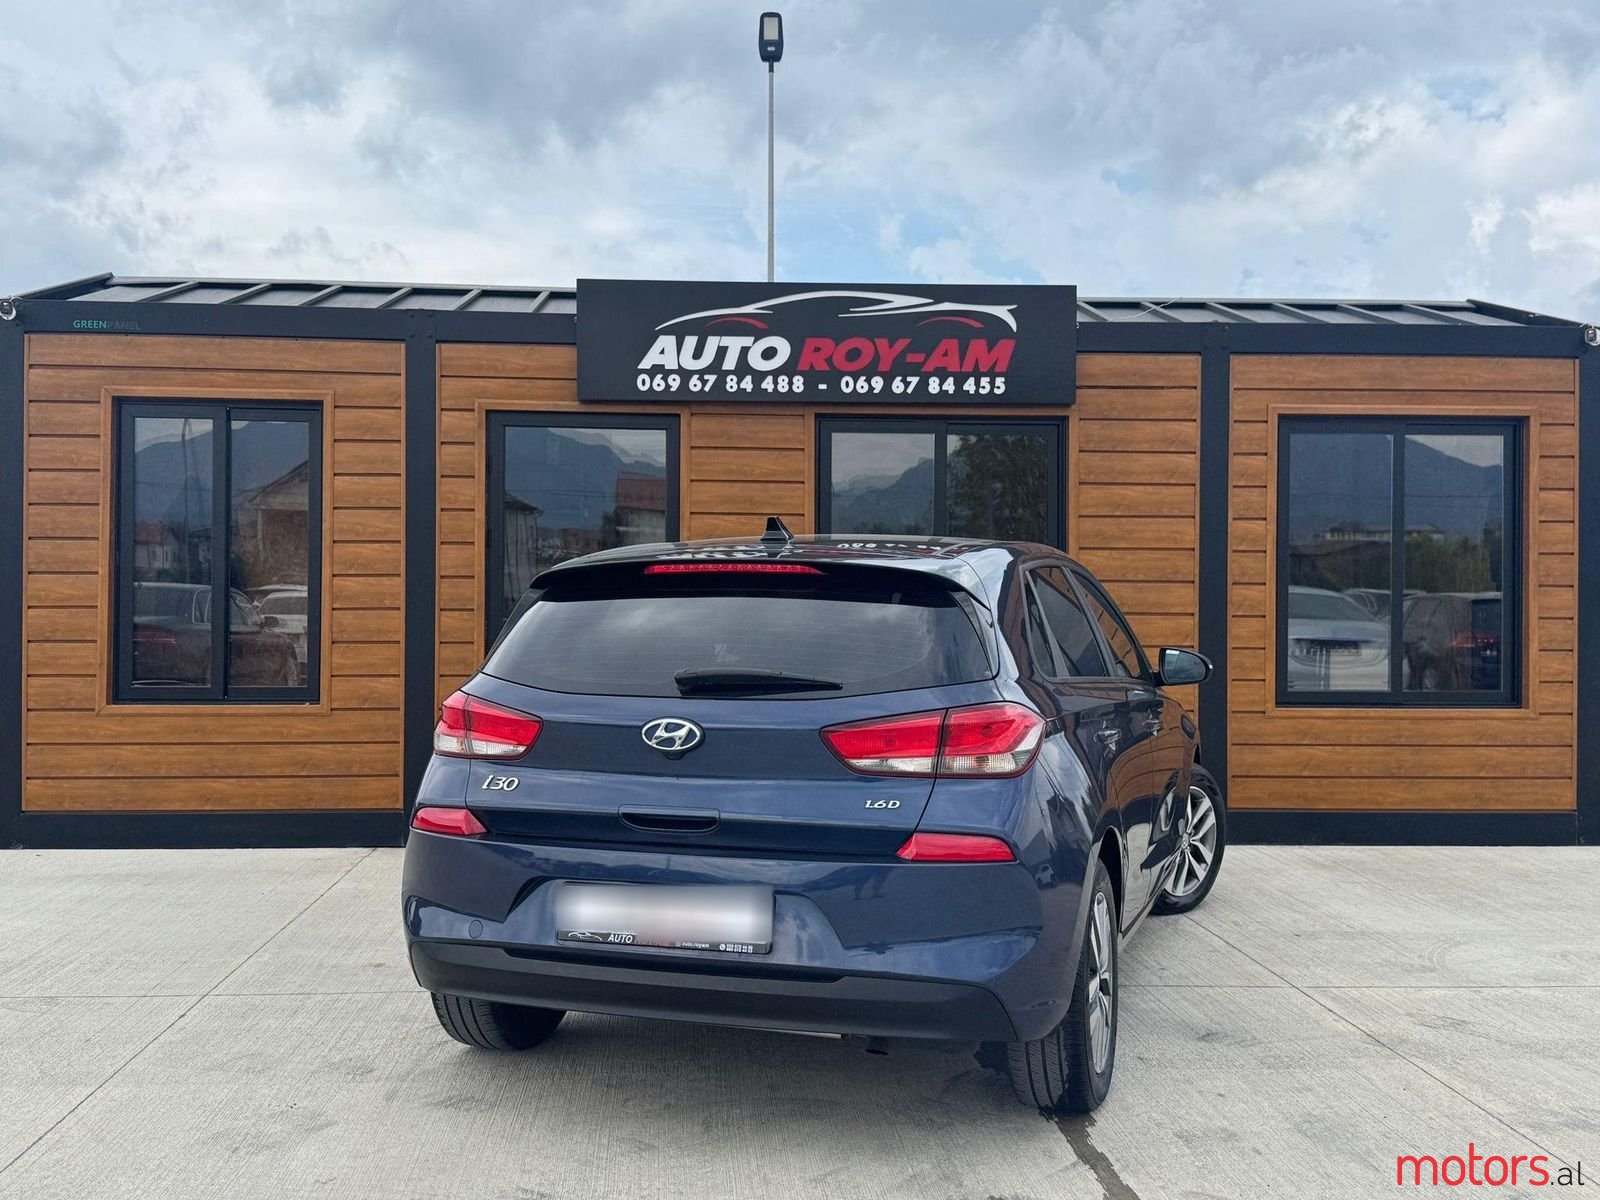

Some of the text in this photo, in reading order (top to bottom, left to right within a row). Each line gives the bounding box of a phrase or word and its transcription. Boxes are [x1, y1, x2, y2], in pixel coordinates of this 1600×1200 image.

[637, 335, 1016, 372] AUTO ROY-AM
[636, 373, 681, 392] 069
[688, 374, 718, 392] 67
[725, 374, 754, 393] 84
[760, 375, 805, 393] 488
[840, 376, 884, 394] 069
[891, 376, 920, 395] 67
[928, 376, 956, 395] 84
[963, 376, 1006, 395] 455
[607, 934, 633, 944] AUTO
